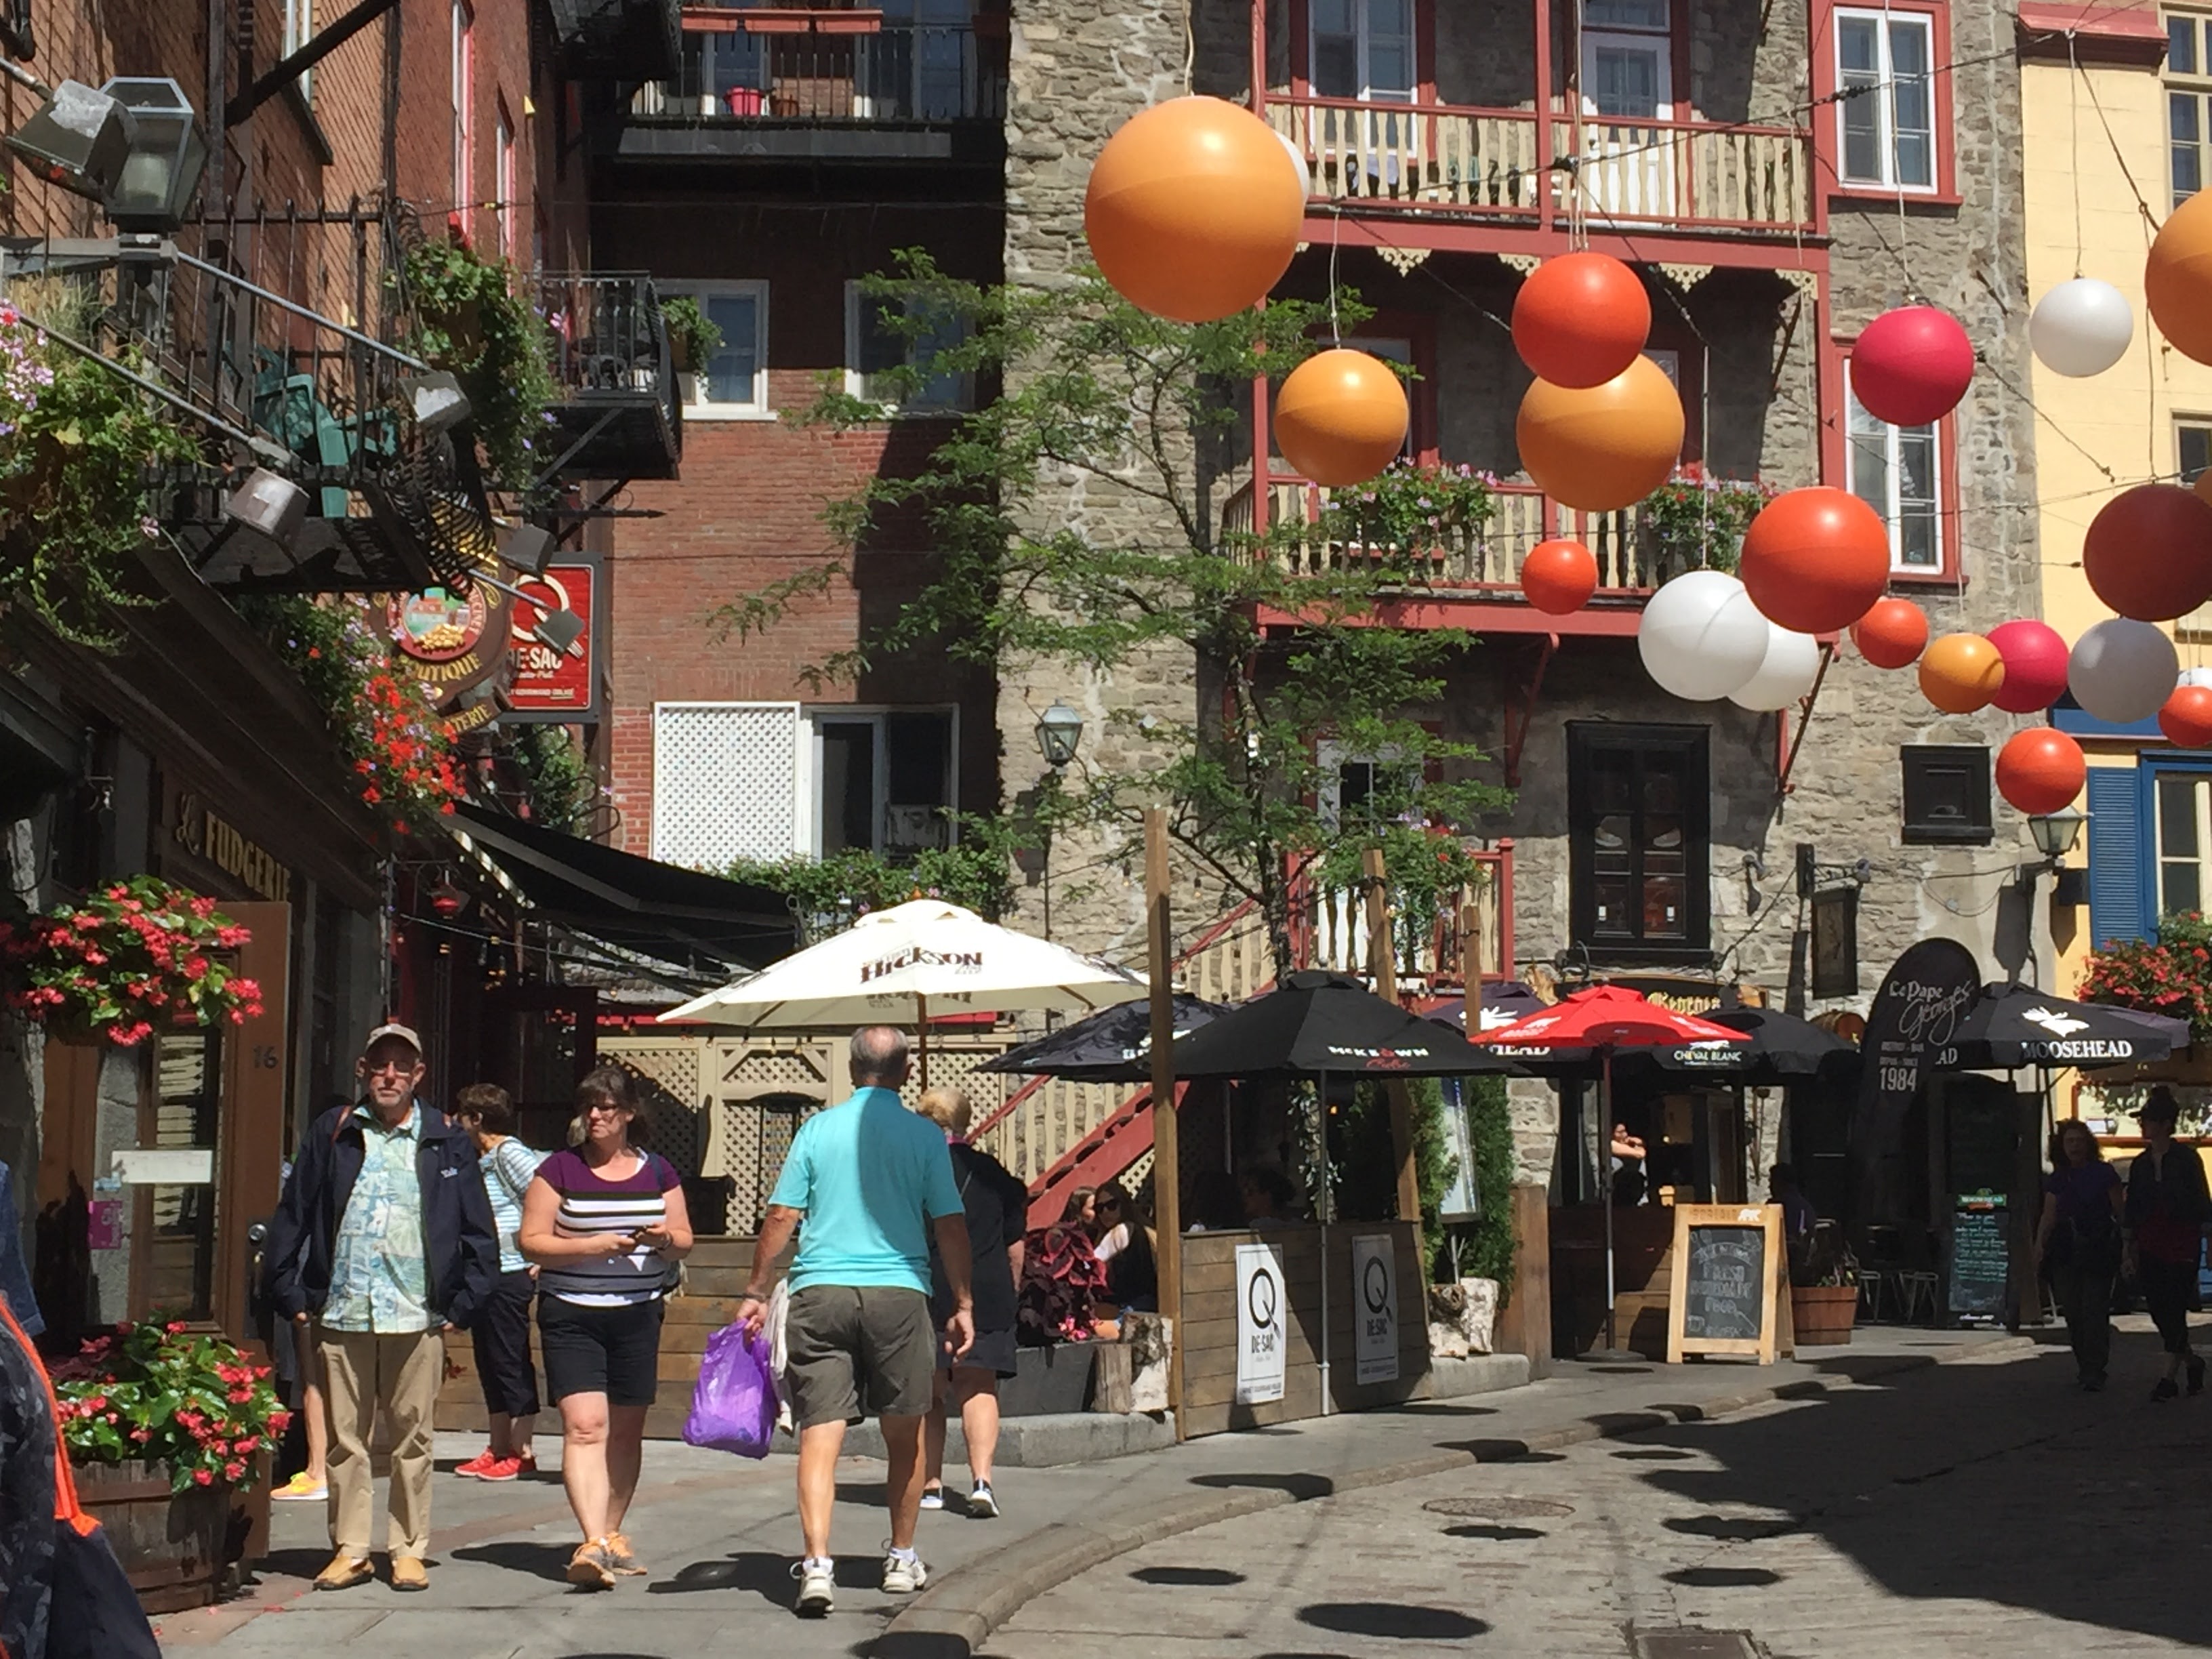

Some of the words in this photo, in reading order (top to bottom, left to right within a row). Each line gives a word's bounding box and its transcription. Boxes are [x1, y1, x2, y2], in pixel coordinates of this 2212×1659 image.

[1907, 980, 1944, 1002] Pape
[1899, 979, 1975, 1046] Georges
[253, 1046, 279, 1069] 16
[2021, 1040, 2133, 1059] MOOSEHEAD
[1880, 1067, 1918, 1092] 1984
